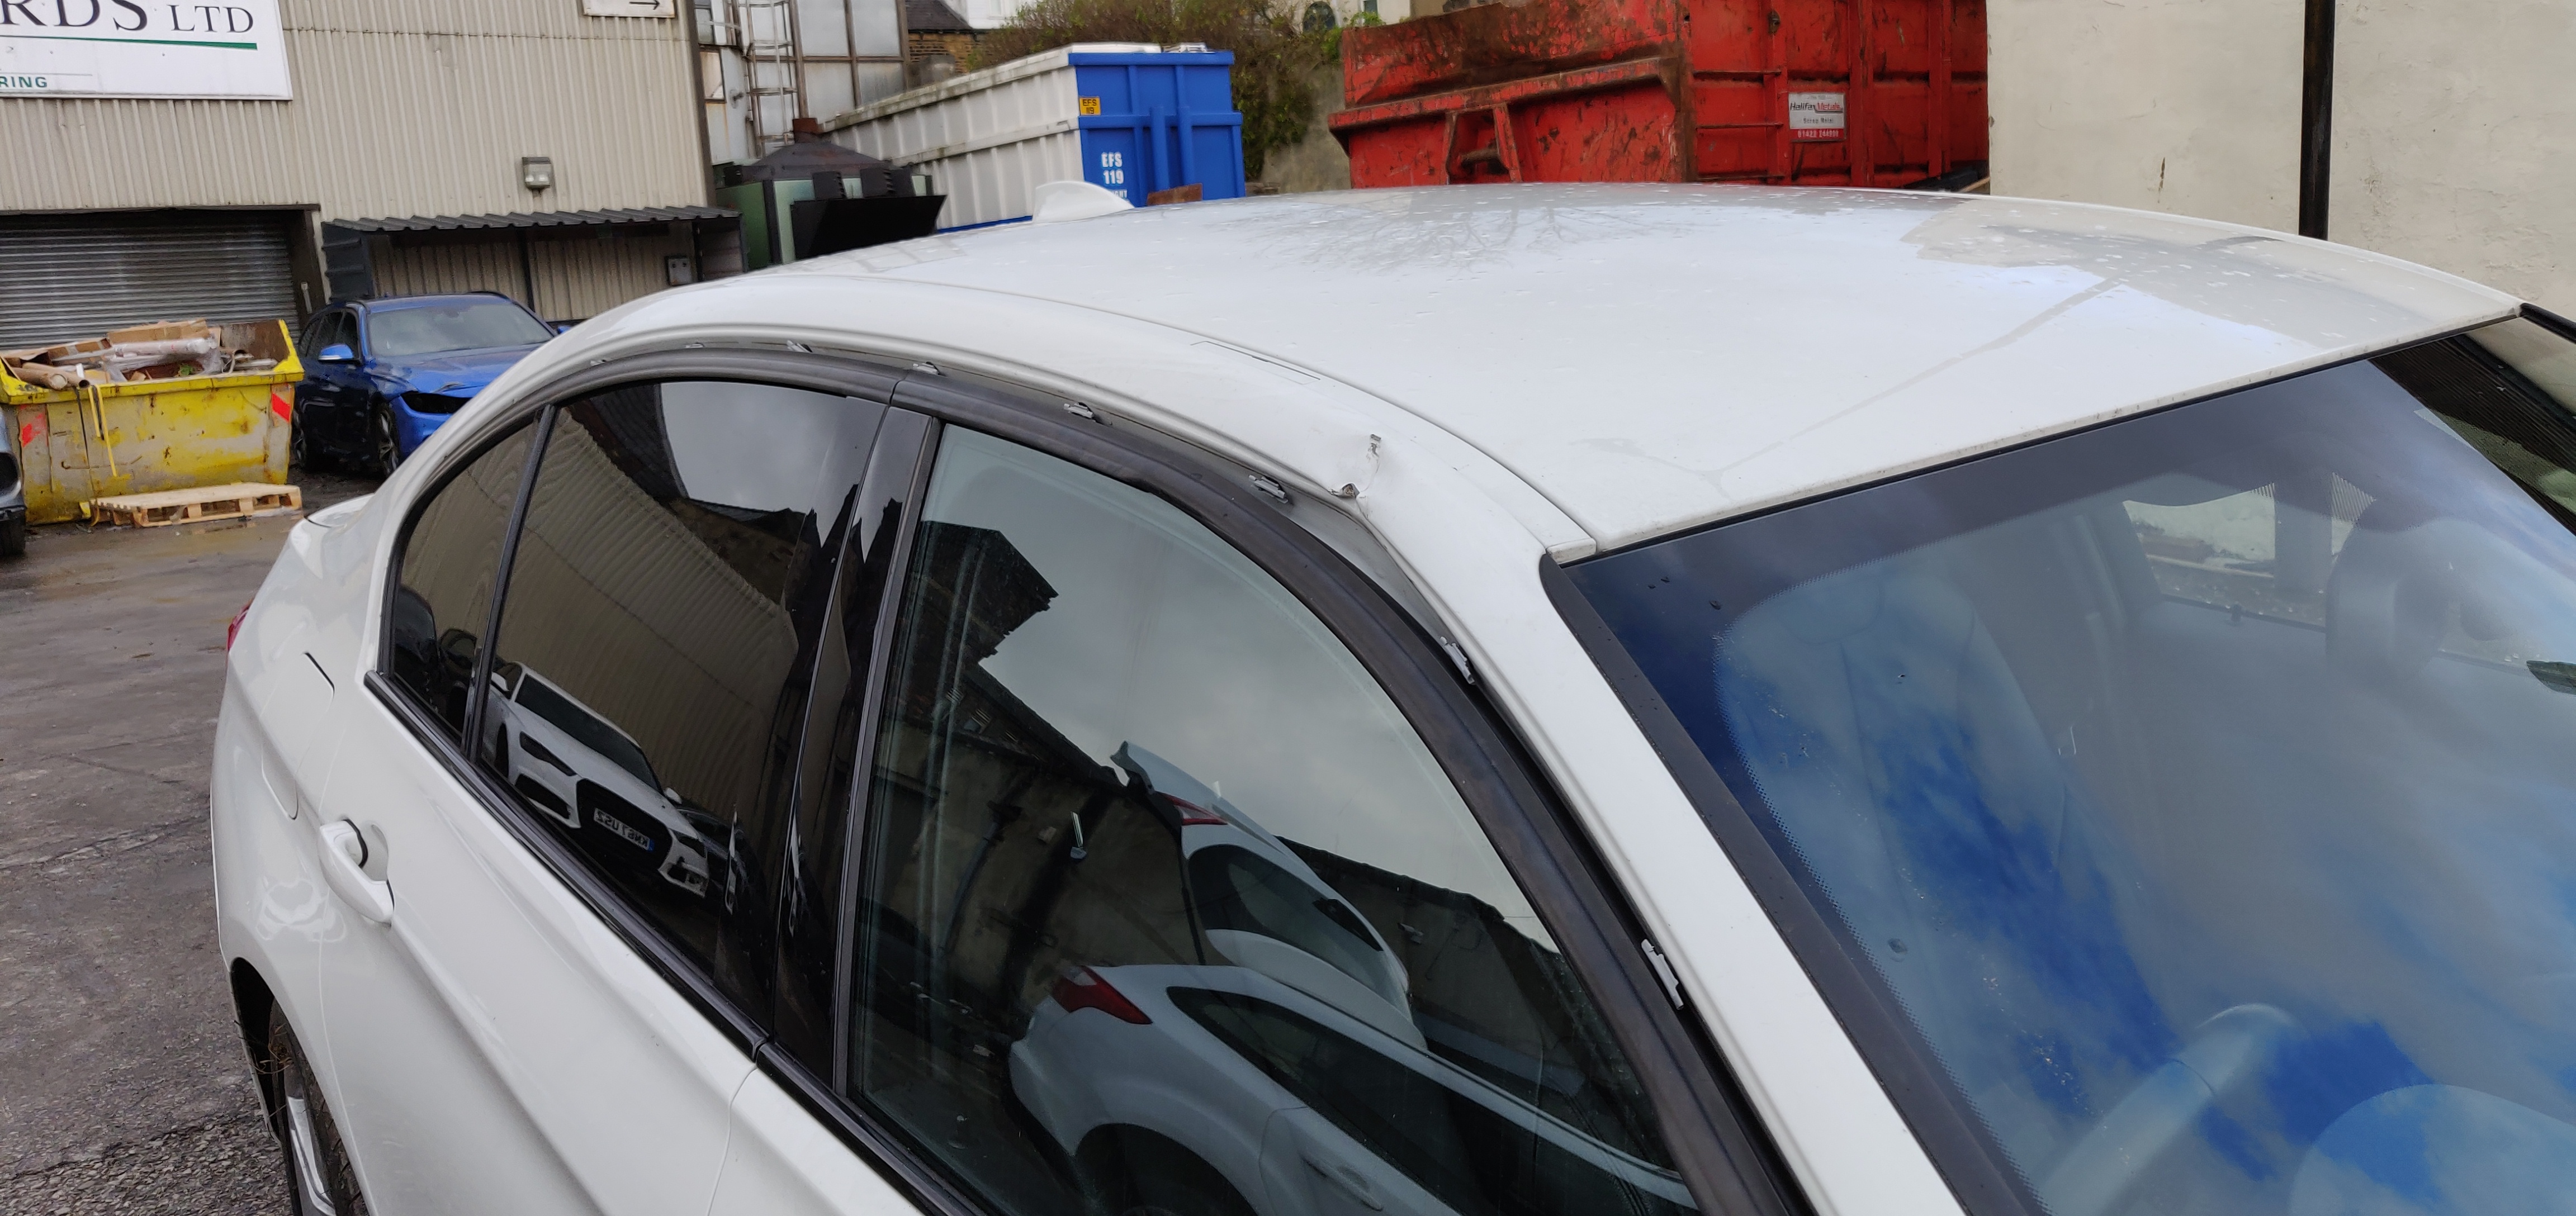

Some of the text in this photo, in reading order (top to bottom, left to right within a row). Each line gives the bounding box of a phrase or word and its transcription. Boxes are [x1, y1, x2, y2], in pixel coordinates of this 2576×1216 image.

[168, 4, 253, 33] LTD
[0, 76, 48, 88] RING
[1101, 152, 1122, 168] EFS
[1103, 169, 1124, 184] 119
